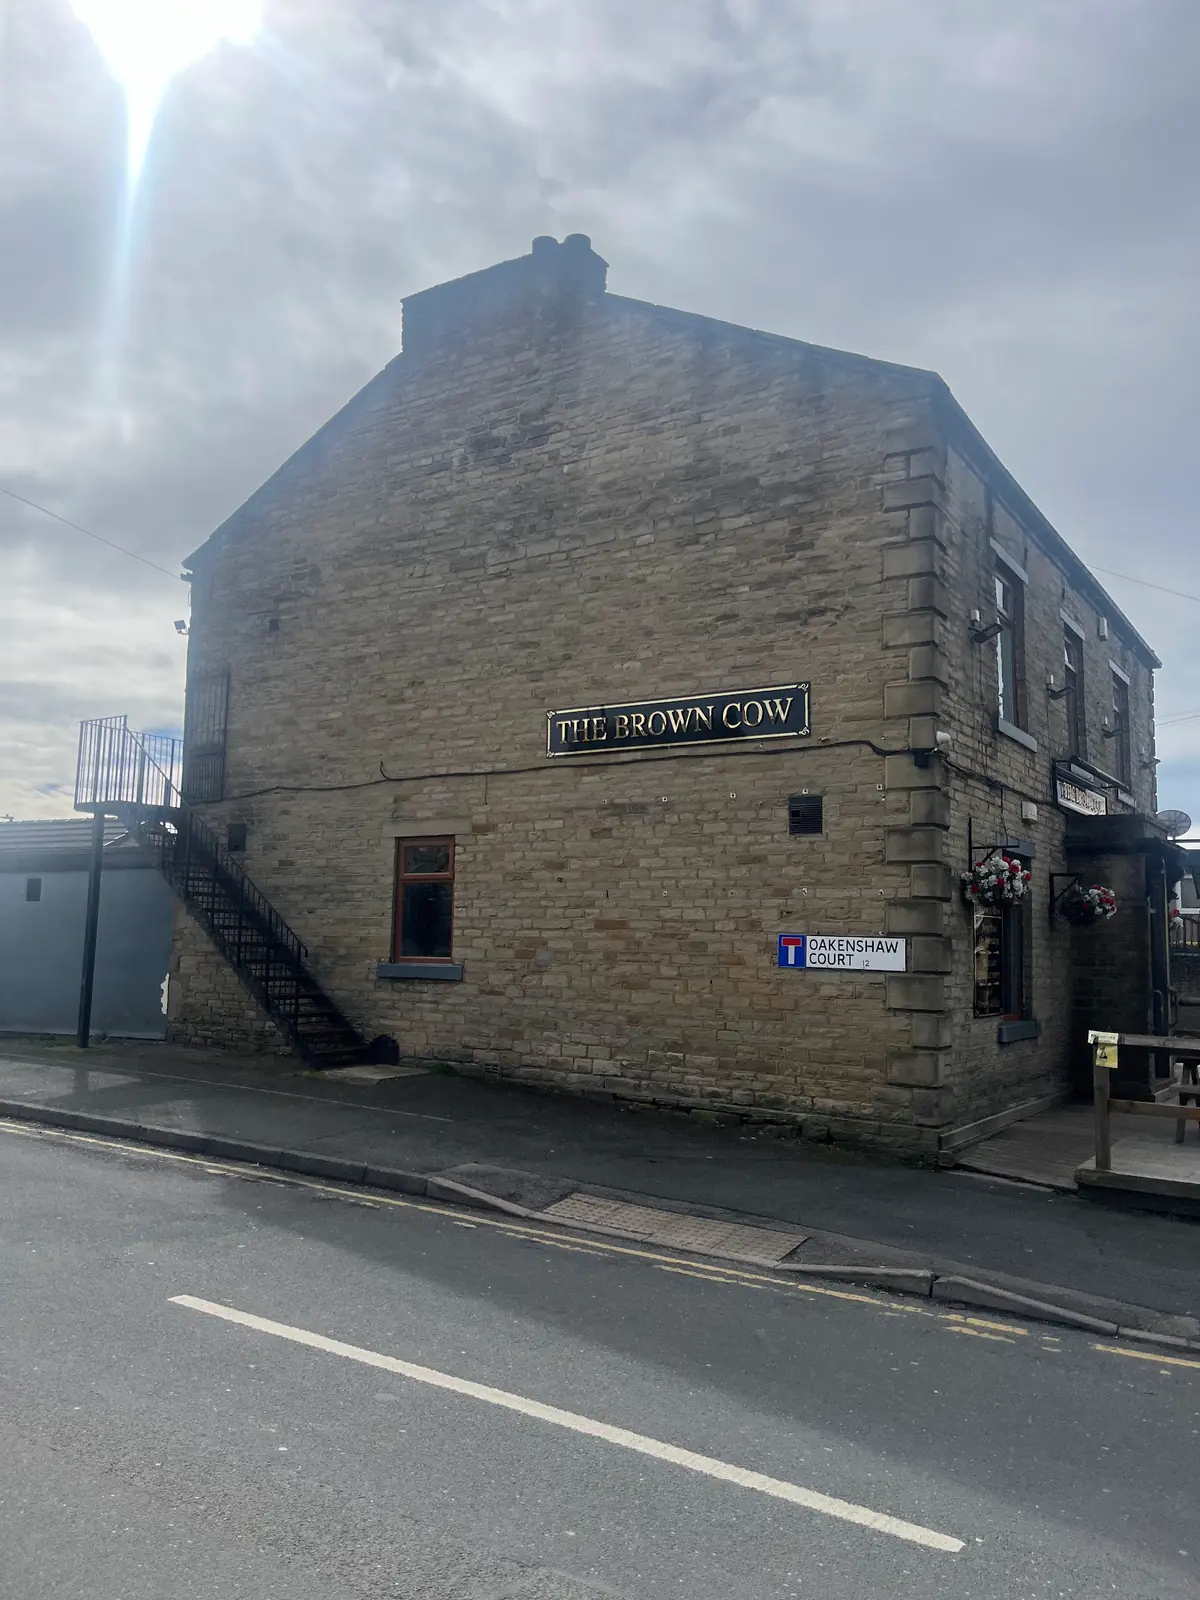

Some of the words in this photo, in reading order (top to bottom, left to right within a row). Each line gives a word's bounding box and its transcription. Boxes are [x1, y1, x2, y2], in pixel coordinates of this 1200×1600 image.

[556, 717, 607, 744] THE
[614, 705, 715, 739] BROWN
[722, 697, 794, 729] COW
[809, 938, 898, 953] OAKENSHAW
[809, 953, 854, 966] COURT
